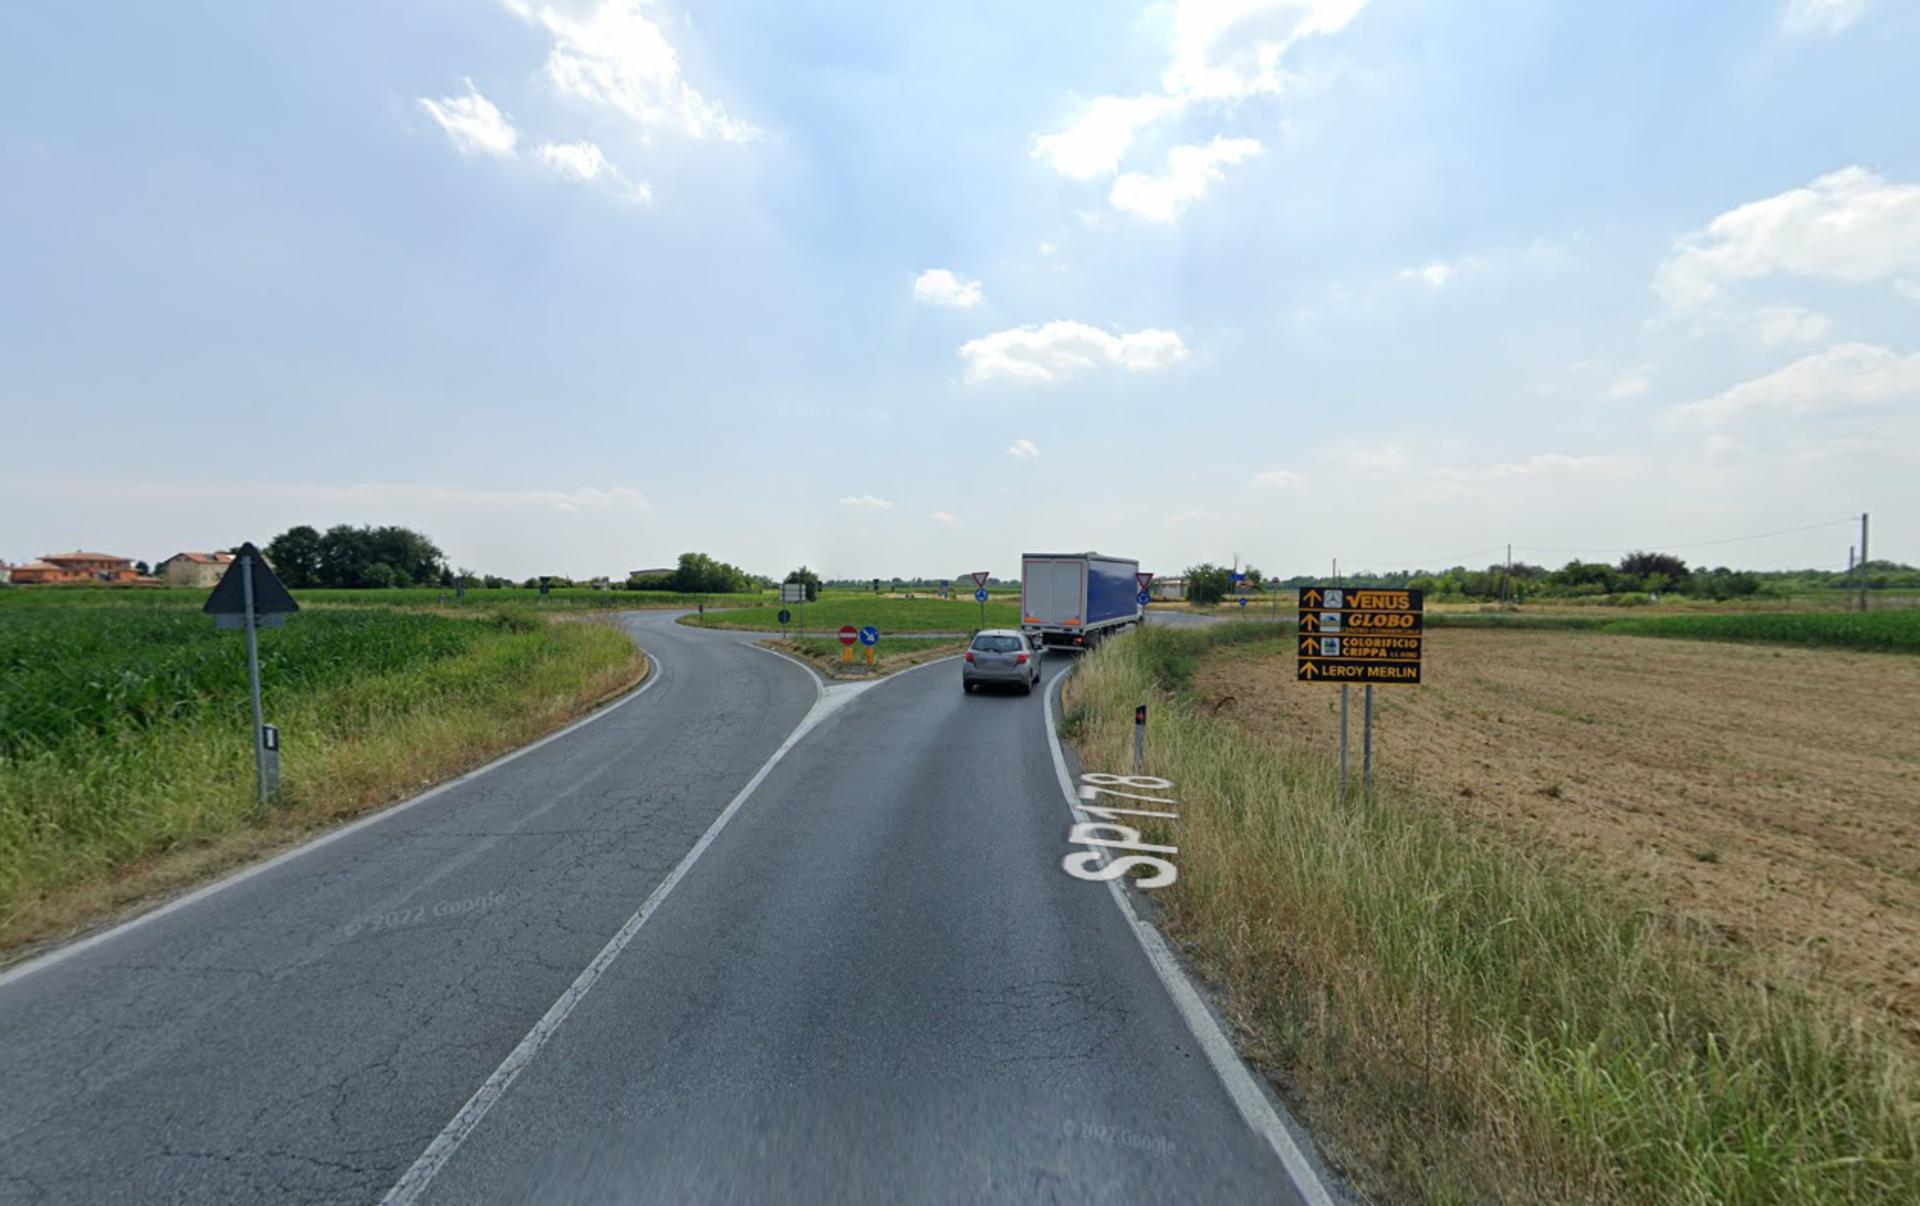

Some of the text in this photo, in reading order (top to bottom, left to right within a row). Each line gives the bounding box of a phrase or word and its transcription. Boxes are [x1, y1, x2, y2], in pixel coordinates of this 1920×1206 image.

[1346, 591, 1409, 609] VENUS
[1348, 613, 1414, 627] GLOBO
[1342, 637, 1418, 649] COLORIFICIO
[1322, 665, 1417, 678] LEROY MERLIN
